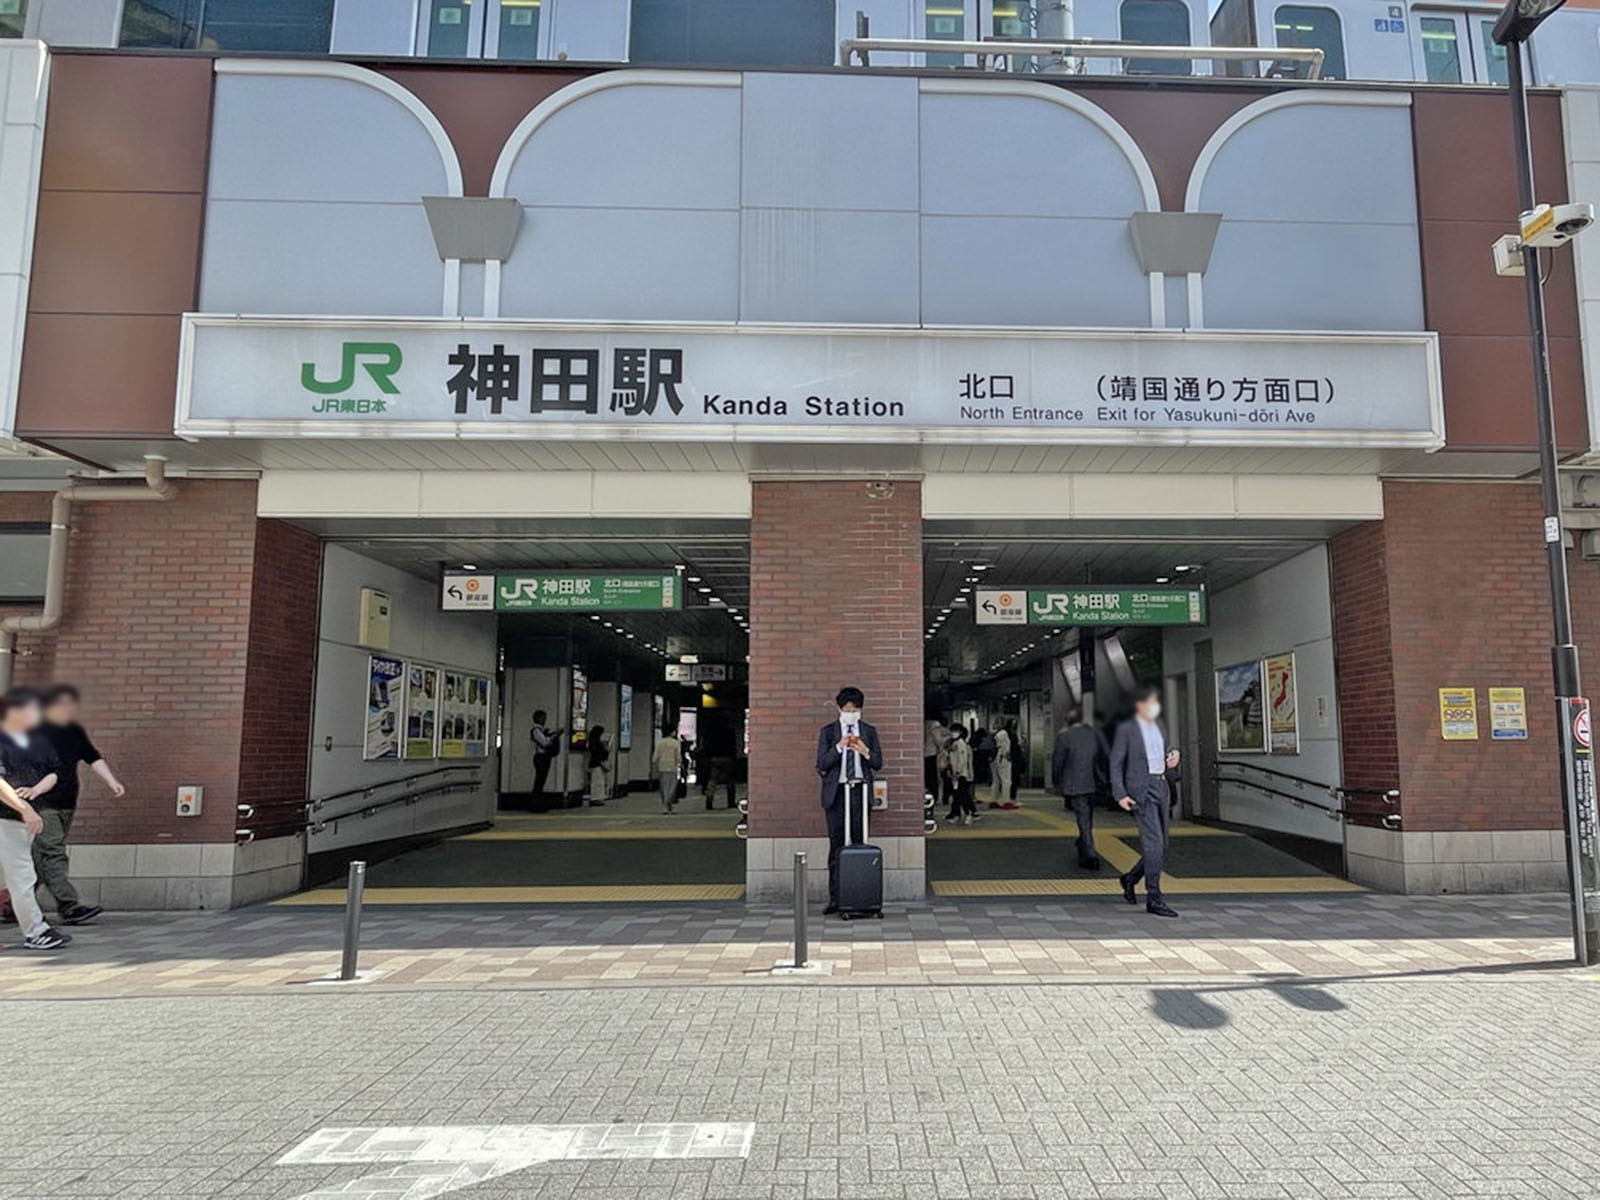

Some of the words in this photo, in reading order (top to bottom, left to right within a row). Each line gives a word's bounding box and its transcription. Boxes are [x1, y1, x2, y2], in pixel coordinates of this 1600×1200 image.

[301, 342, 403, 395] JR
[446, 343, 684, 417] 神田駅
[959, 373, 1015, 400] 北口
[312, 399, 387, 414] JR東日本
[704, 394, 788, 416] Kanda
[805, 396, 904, 417] Station
[960, 406, 1005, 420] North
[1012, 407, 1084, 421] Entrance
[1097, 407, 1128, 422] Exit
[1133, 408, 1157, 422] for
[1285, 409, 1316, 424] Ave
[500, 578, 538, 599] JR
[542, 578, 591, 595] 神田駅
[541, 597, 569, 606] Kanda
[571, 596, 600, 606] Station
[1033, 593, 1069, 614] JR
[1073, 594, 1120, 610] 神田駅
[1072, 611, 1099, 621] Kanda
[1101, 611, 1130, 620] Station
